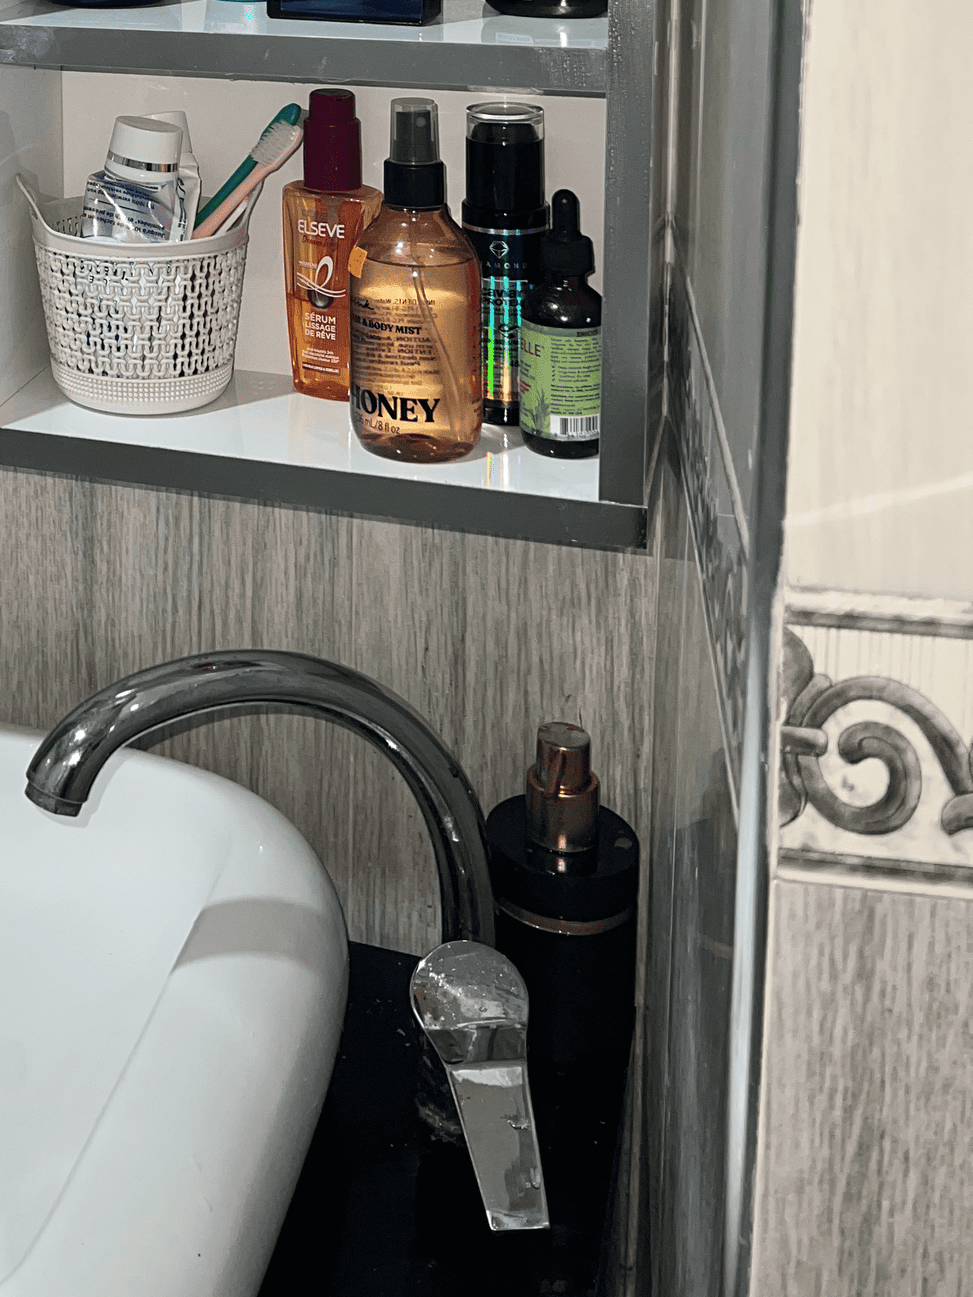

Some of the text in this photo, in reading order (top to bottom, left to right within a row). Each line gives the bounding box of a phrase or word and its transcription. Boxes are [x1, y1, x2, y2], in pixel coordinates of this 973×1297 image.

[298, 219, 345, 239] ELSEVE
[485, 262, 527, 270] AMOND
[305, 312, 336, 324] SÉRUM
[305, 321, 336, 333] LISSAGE
[368, 320, 393, 333] BODY
[395, 324, 422, 335] MIST
[305, 329, 336, 341] DE RÊVE
[351, 384, 440, 423] HONEY
[391, 426, 401, 434] oz
